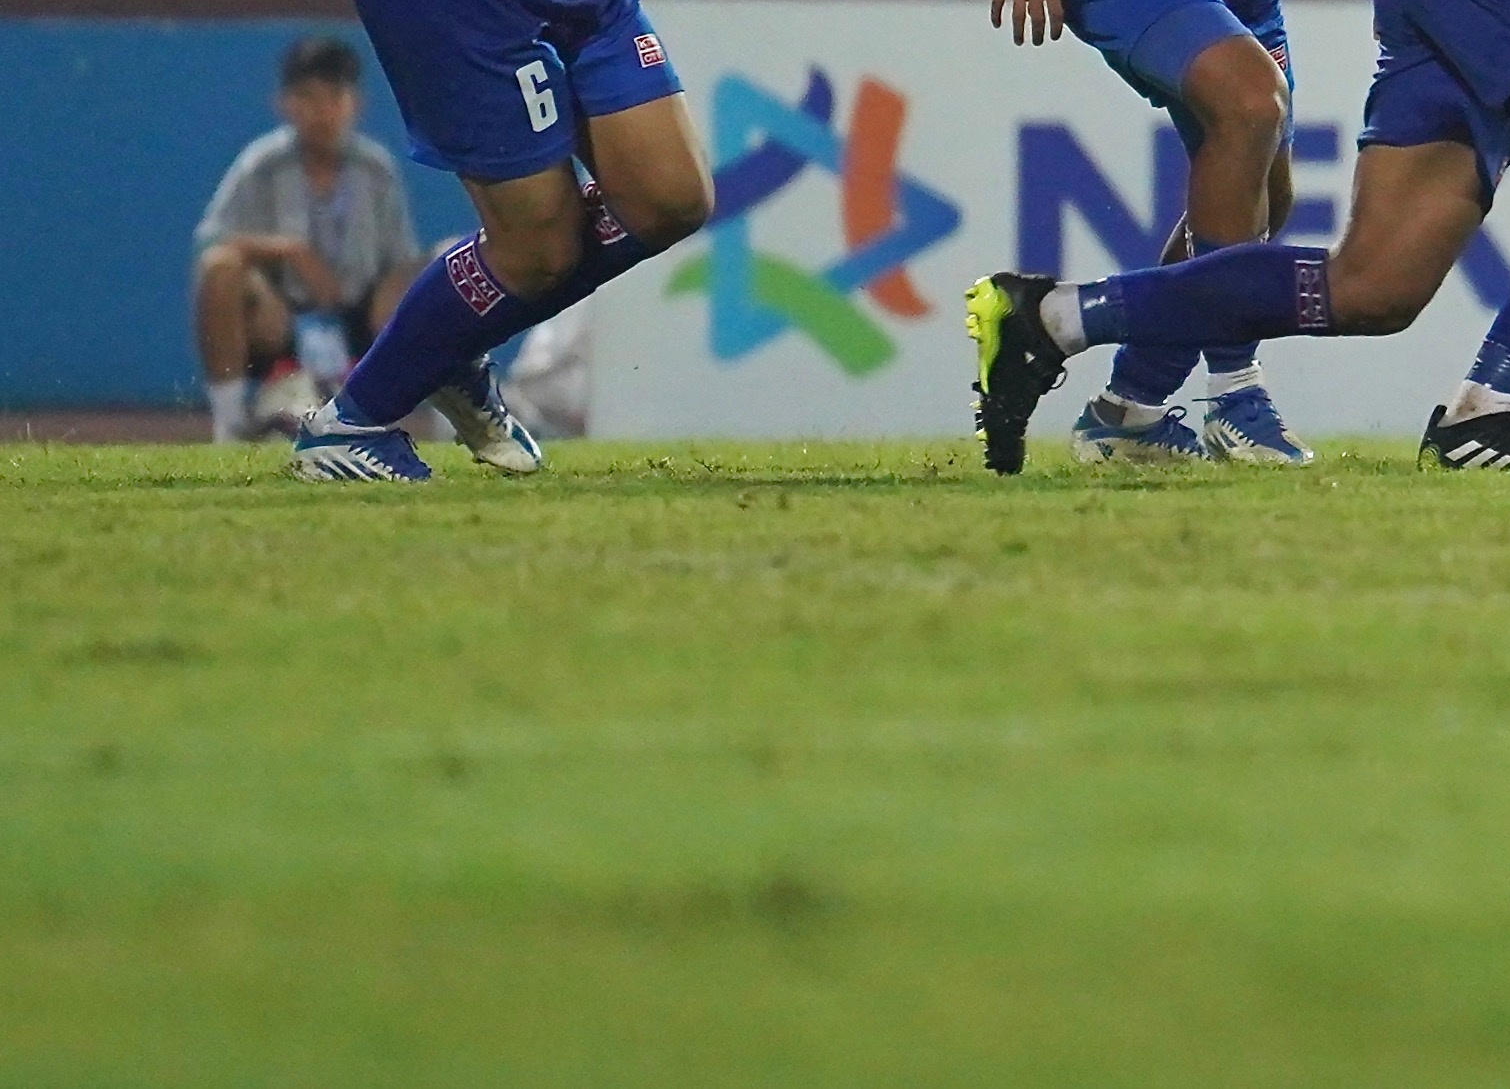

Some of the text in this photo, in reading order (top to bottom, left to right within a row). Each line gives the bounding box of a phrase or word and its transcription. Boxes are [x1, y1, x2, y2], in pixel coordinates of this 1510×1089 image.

[515, 59, 559, 133] 6
[450, 258, 483, 304] CTY
[462, 249, 498, 299] KTM
